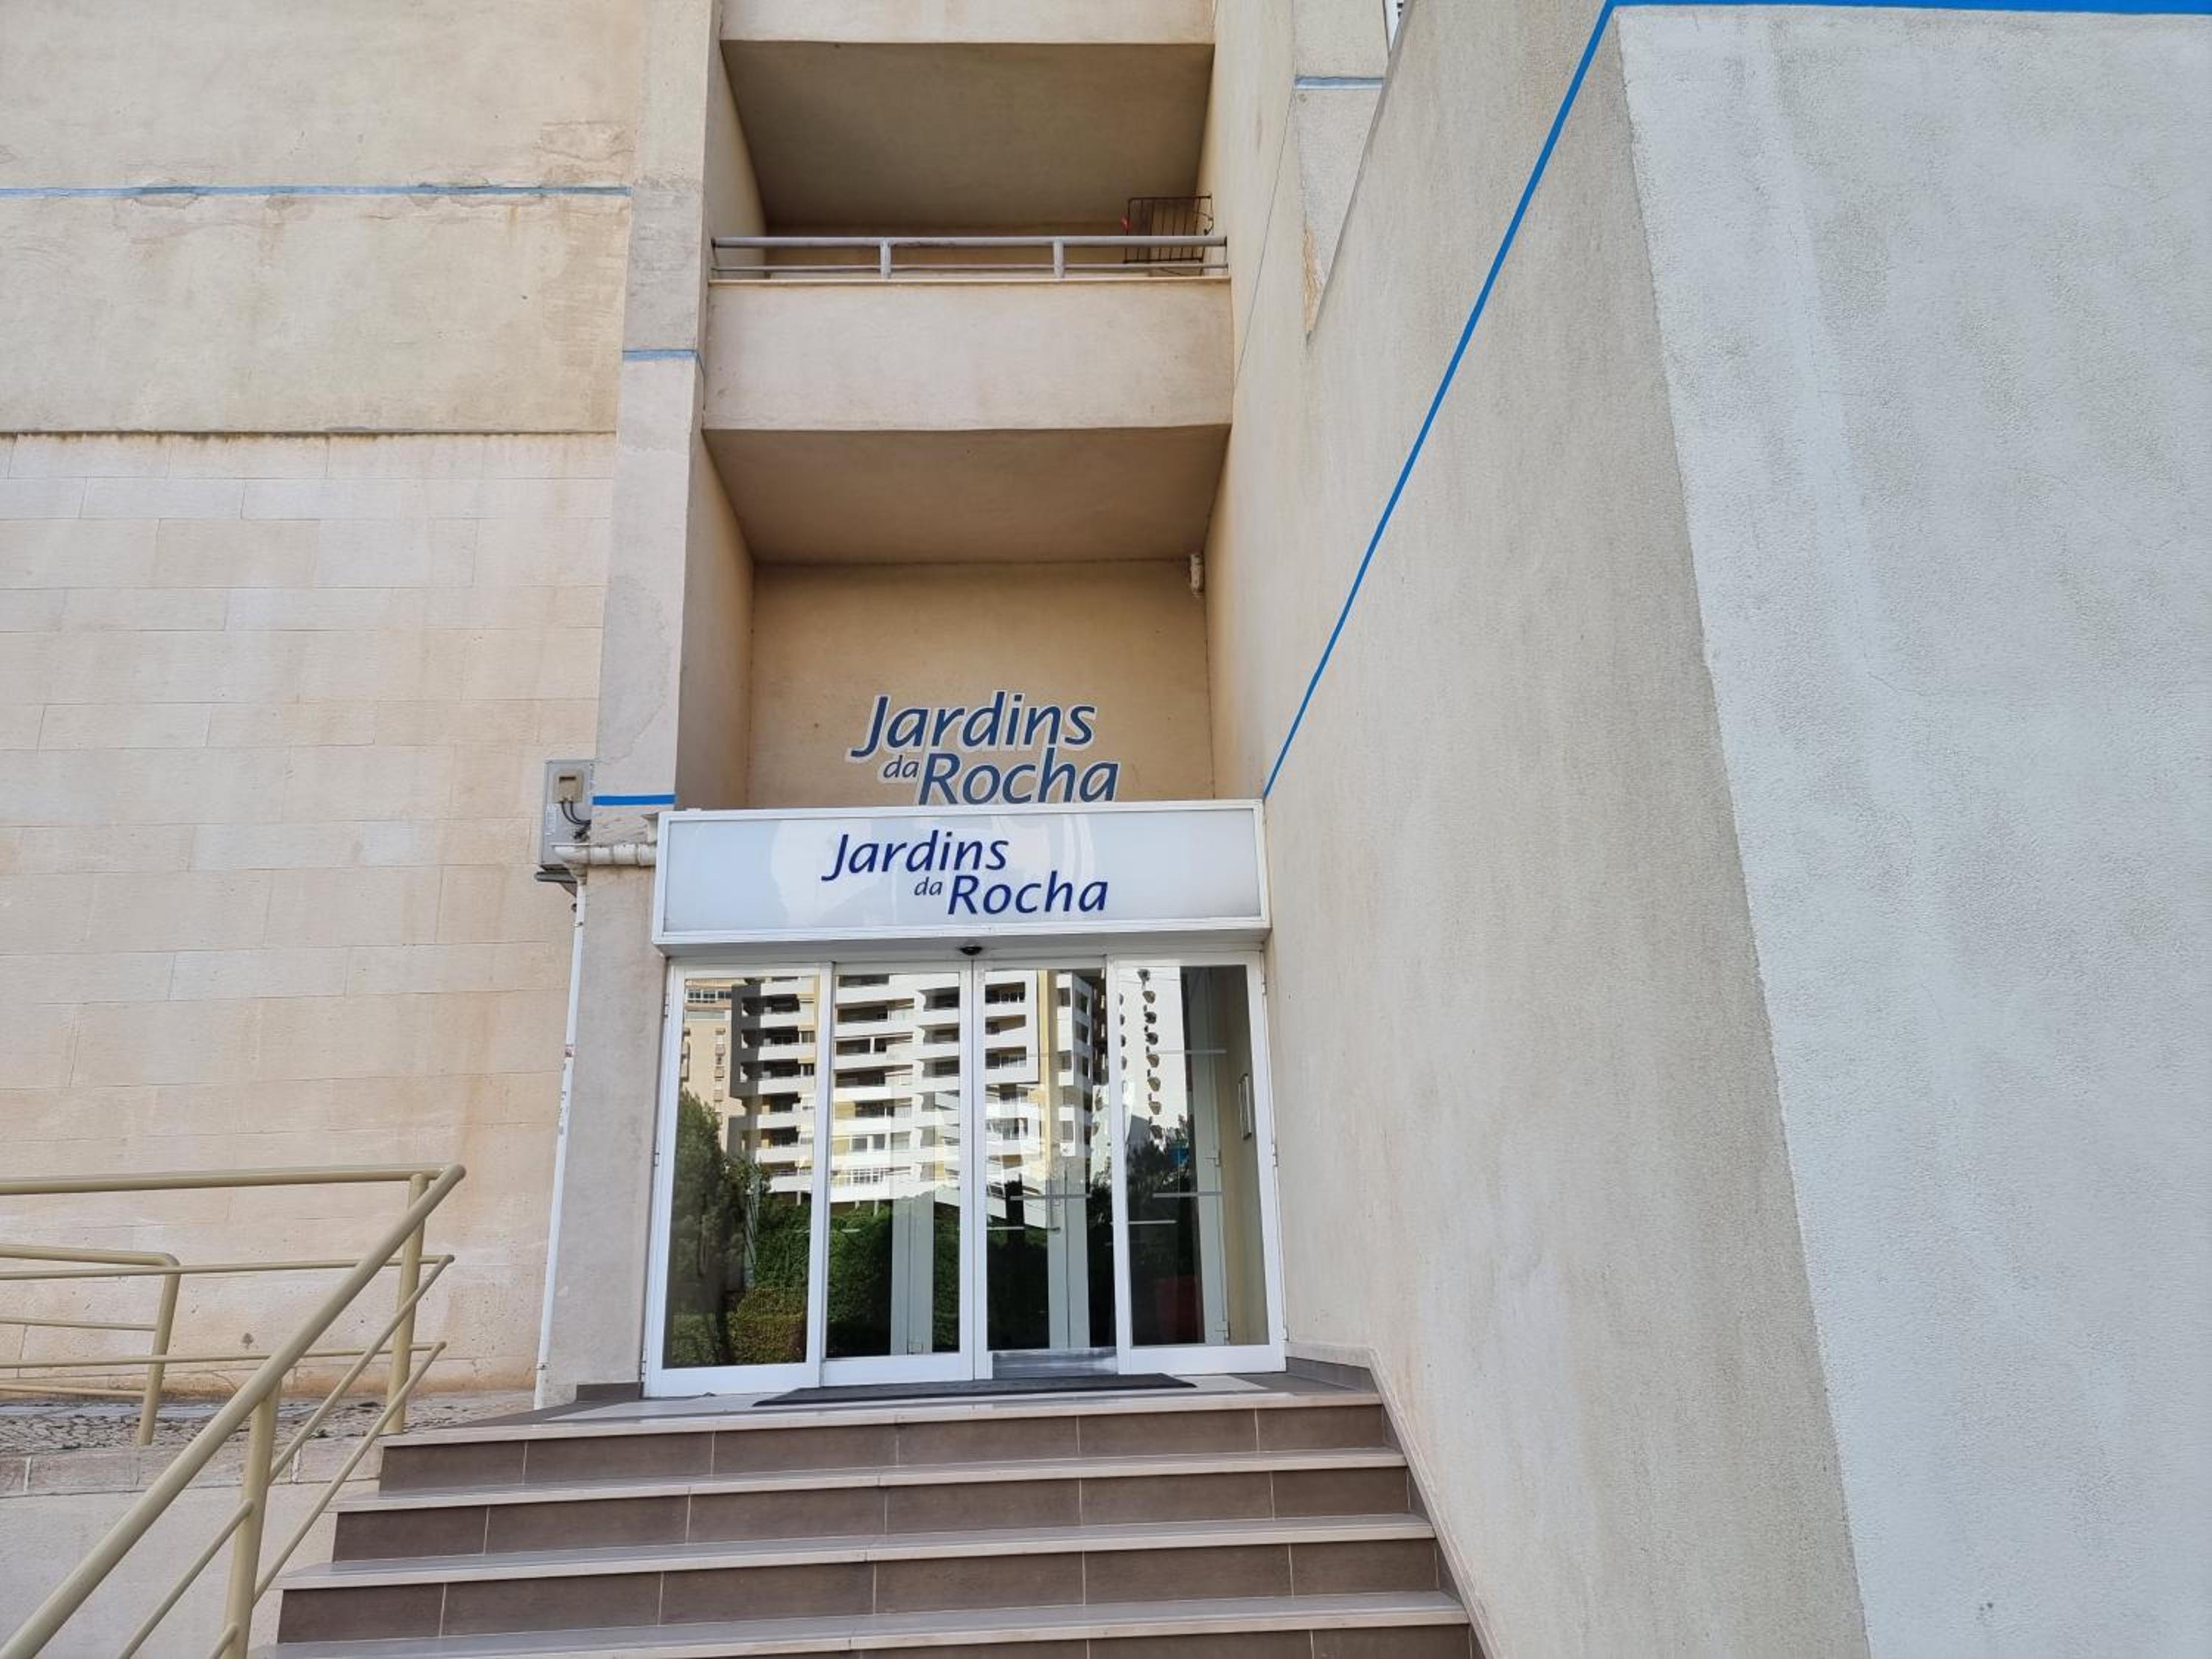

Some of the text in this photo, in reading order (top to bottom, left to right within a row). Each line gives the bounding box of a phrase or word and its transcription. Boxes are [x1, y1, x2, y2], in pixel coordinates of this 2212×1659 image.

[850, 691, 1096, 758] Jardins
[883, 746, 1119, 806] da Rocha
[820, 830, 1010, 882] Jardins
[914, 870, 1109, 915] da Rocha
